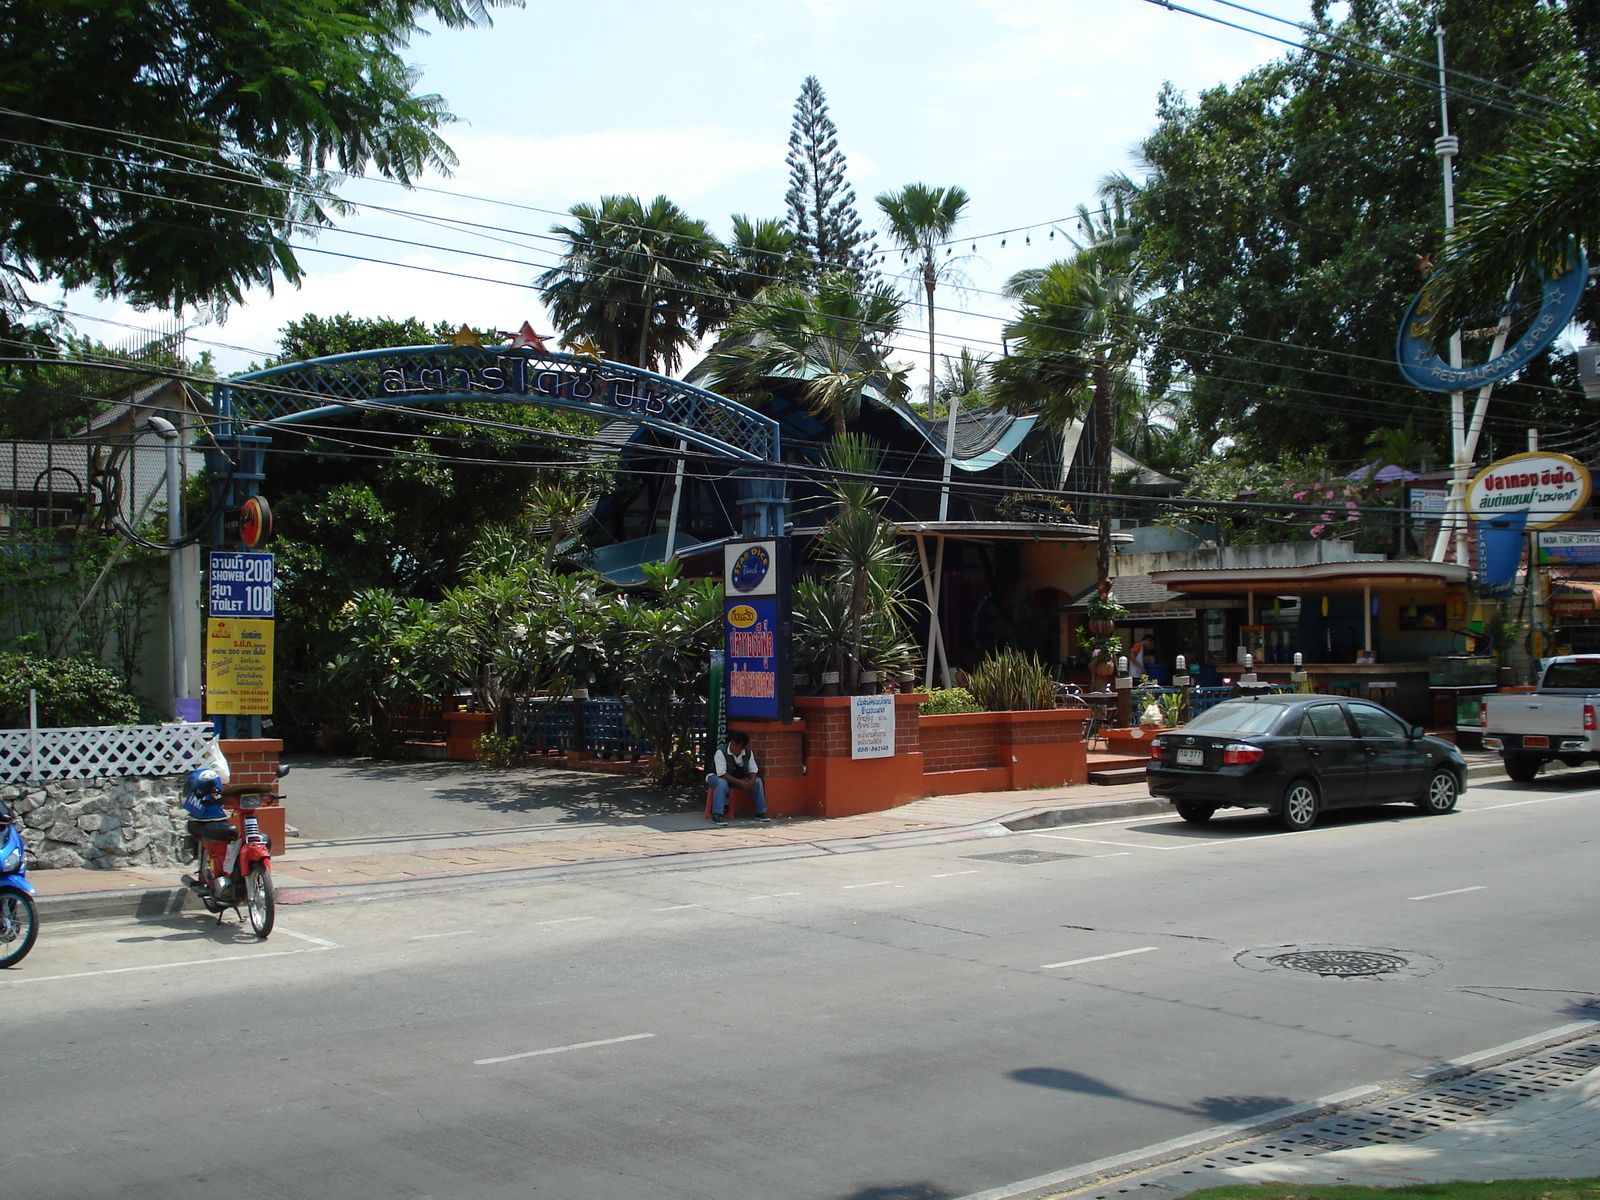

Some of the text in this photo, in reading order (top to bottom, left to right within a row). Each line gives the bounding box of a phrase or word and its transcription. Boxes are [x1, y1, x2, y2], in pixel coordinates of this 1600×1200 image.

[1431, 314, 1555, 382] RESTAURANT & PUB
[1559, 536, 1574, 544] TOUR
[212, 554, 244, 569] อาบน้ำ
[734, 548, 768, 575] STAR DICE
[212, 570, 244, 581] SHOWER
[212, 584, 232, 599] สุขา
[1190, 750, 1201, 758] 377
